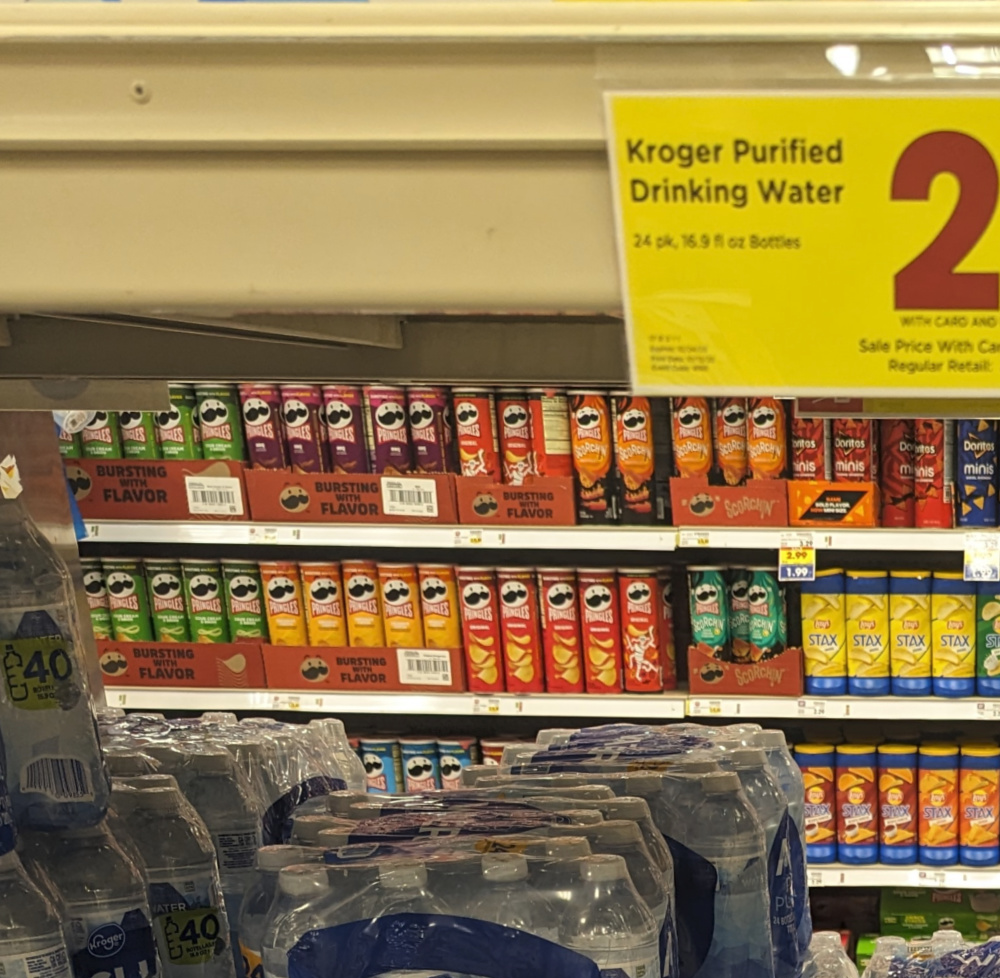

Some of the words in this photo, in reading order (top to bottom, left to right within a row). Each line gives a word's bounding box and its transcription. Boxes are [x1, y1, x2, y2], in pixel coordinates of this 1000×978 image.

[626, 138, 724, 168] Kroger
[733, 137, 844, 164] Purified
[630, 178, 748, 208] Drinking
[757, 180, 845, 204] Water
[633, 234, 652, 248] 24
[681, 234, 710, 249] 16.9
[713, 233, 725, 249] fl
[728, 236, 745, 249] oz
[749, 234, 801, 249] Bottles
[900, 317, 931, 328] WITH
[933, 316, 968, 328] CARD
[971, 316, 998, 328] AND
[859, 339, 890, 354] Sale
[895, 339, 932, 353] Price
[936, 339, 974, 353] With
[888, 359, 944, 375] Regular
[948, 359, 992, 373] Retail:
[623, 428, 648, 442] PRINGLES
[674, 425, 698, 440] PRINGLES
[963, 439, 995, 452] Doritos
[96, 465, 167, 479] BURSTING
[963, 463, 994, 476] minis
[315, 482, 379, 493] BURSTING
[103, 489, 168, 503] FLAVOR
[335, 494, 362, 502] WITH
[503, 491, 554, 502] BURSTING
[321, 503, 379, 516] FLAVOR
[519, 501, 540, 509] WITH
[507, 508, 554, 519] FLAVOR
[786, 551, 808, 561] 2.99
[786, 566, 808, 578] 1.99
[464, 604, 492, 622] PRINGLES
[502, 602, 530, 619] PRINGLES
[549, 605, 576, 622] PRINGLES
[585, 605, 615, 623] PRINGLES
[133, 648, 195, 659] BURSTING
[23, 648, 73, 683] 40
[153, 659, 178, 668] WITH
[336, 657, 387, 666] BURSTING
[139, 668, 195, 680] FLAVOR
[340, 673, 387, 683] FLAVOR
[882, 804, 910, 817] STAX
[923, 807, 953, 819] STAX
[964, 807, 994, 819] STAX
[180, 914, 220, 945] 40
